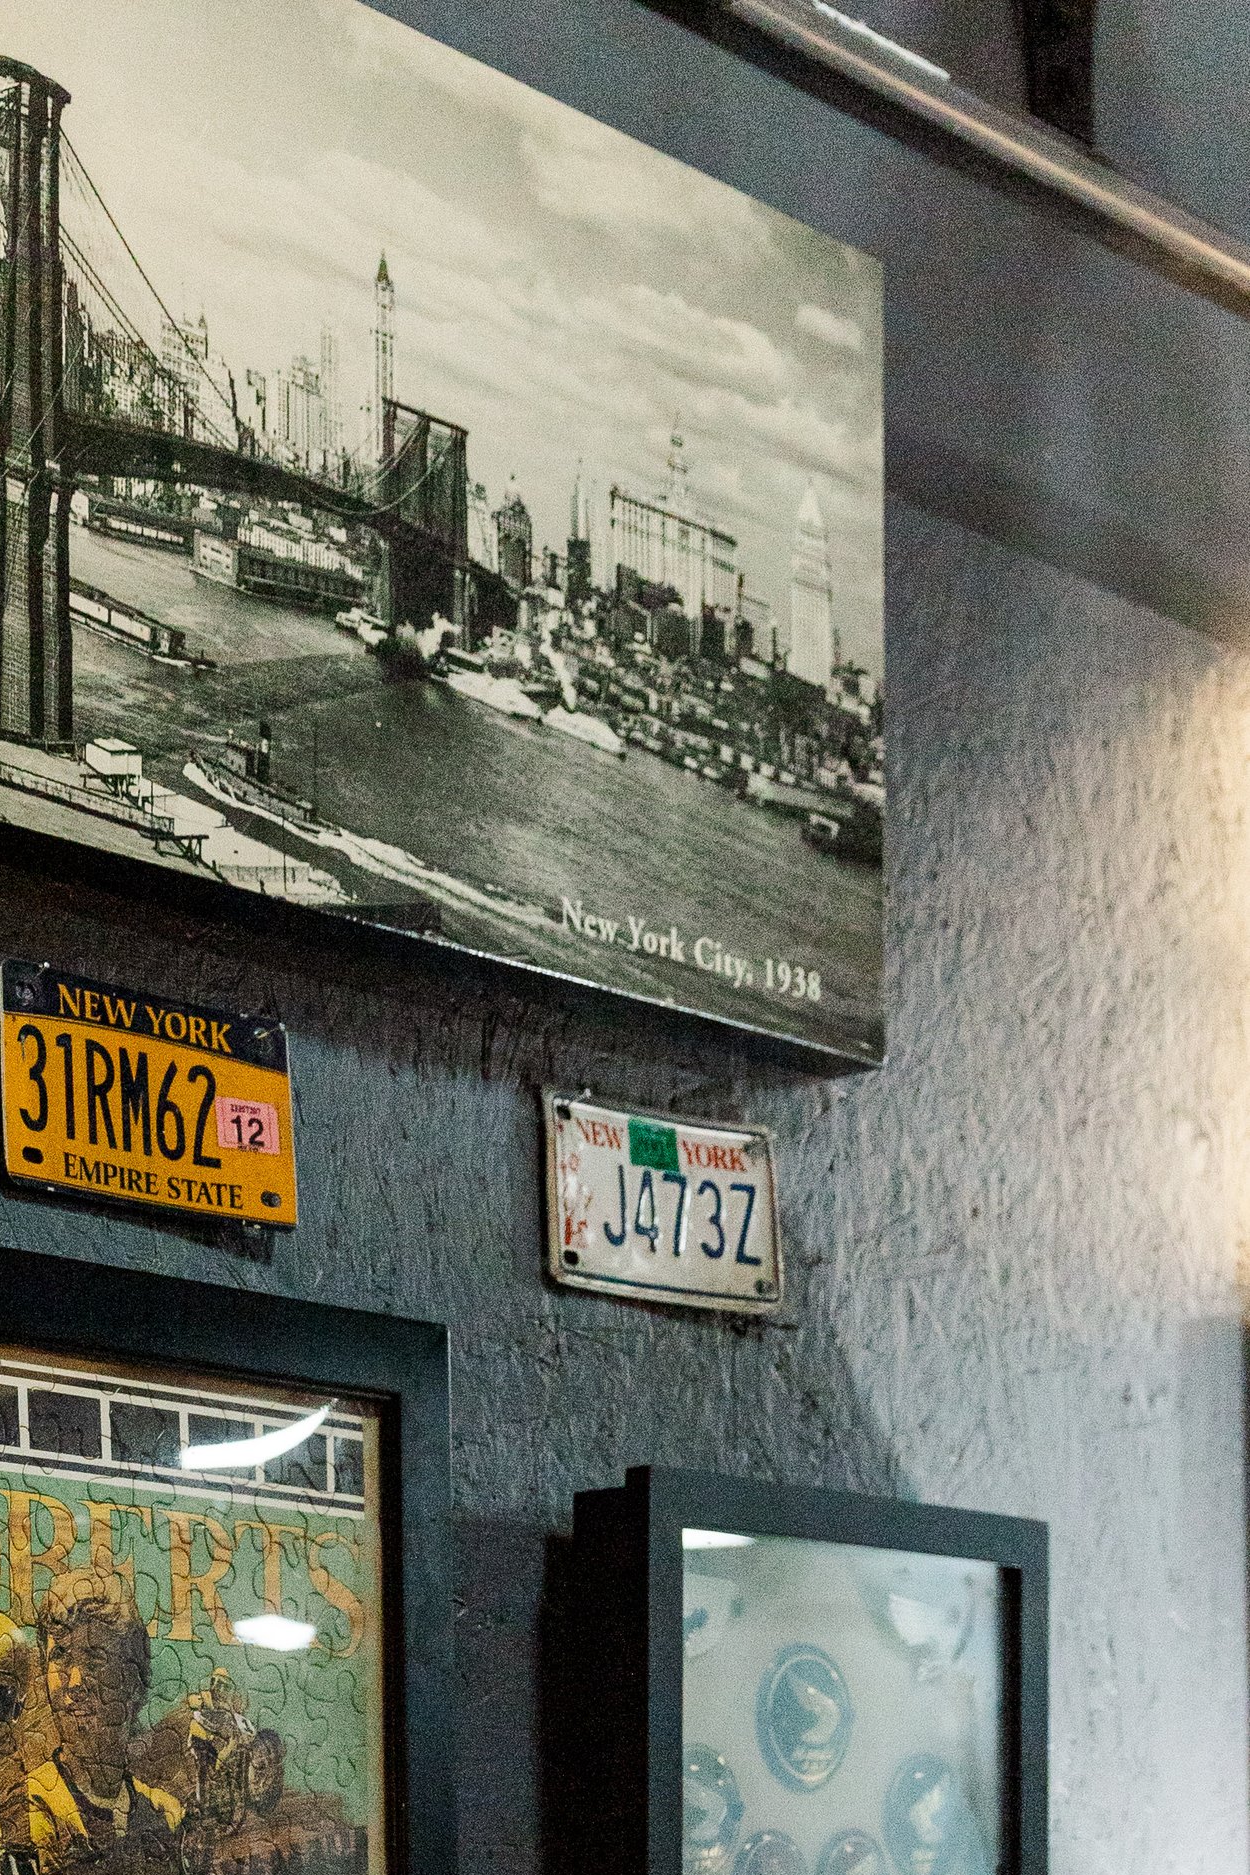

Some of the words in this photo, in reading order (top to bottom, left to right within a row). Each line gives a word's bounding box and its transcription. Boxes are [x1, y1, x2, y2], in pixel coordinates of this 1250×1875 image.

[561, 896, 619, 944] New
[627, 914, 685, 962] York
[764, 957, 822, 1002] 1938
[57, 982, 137, 1029] NEW
[143, 1005, 233, 1054] YORK
[16, 1023, 222, 1170] 31RM62
[230, 1114, 265, 1148] 12
[63, 1151, 160, 1196] EMPIRE
[167, 1175, 244, 1210] STATE
[575, 1116, 624, 1152] NEW
[681, 1138, 748, 1174] YORK
[603, 1164, 762, 1267] J473Z
